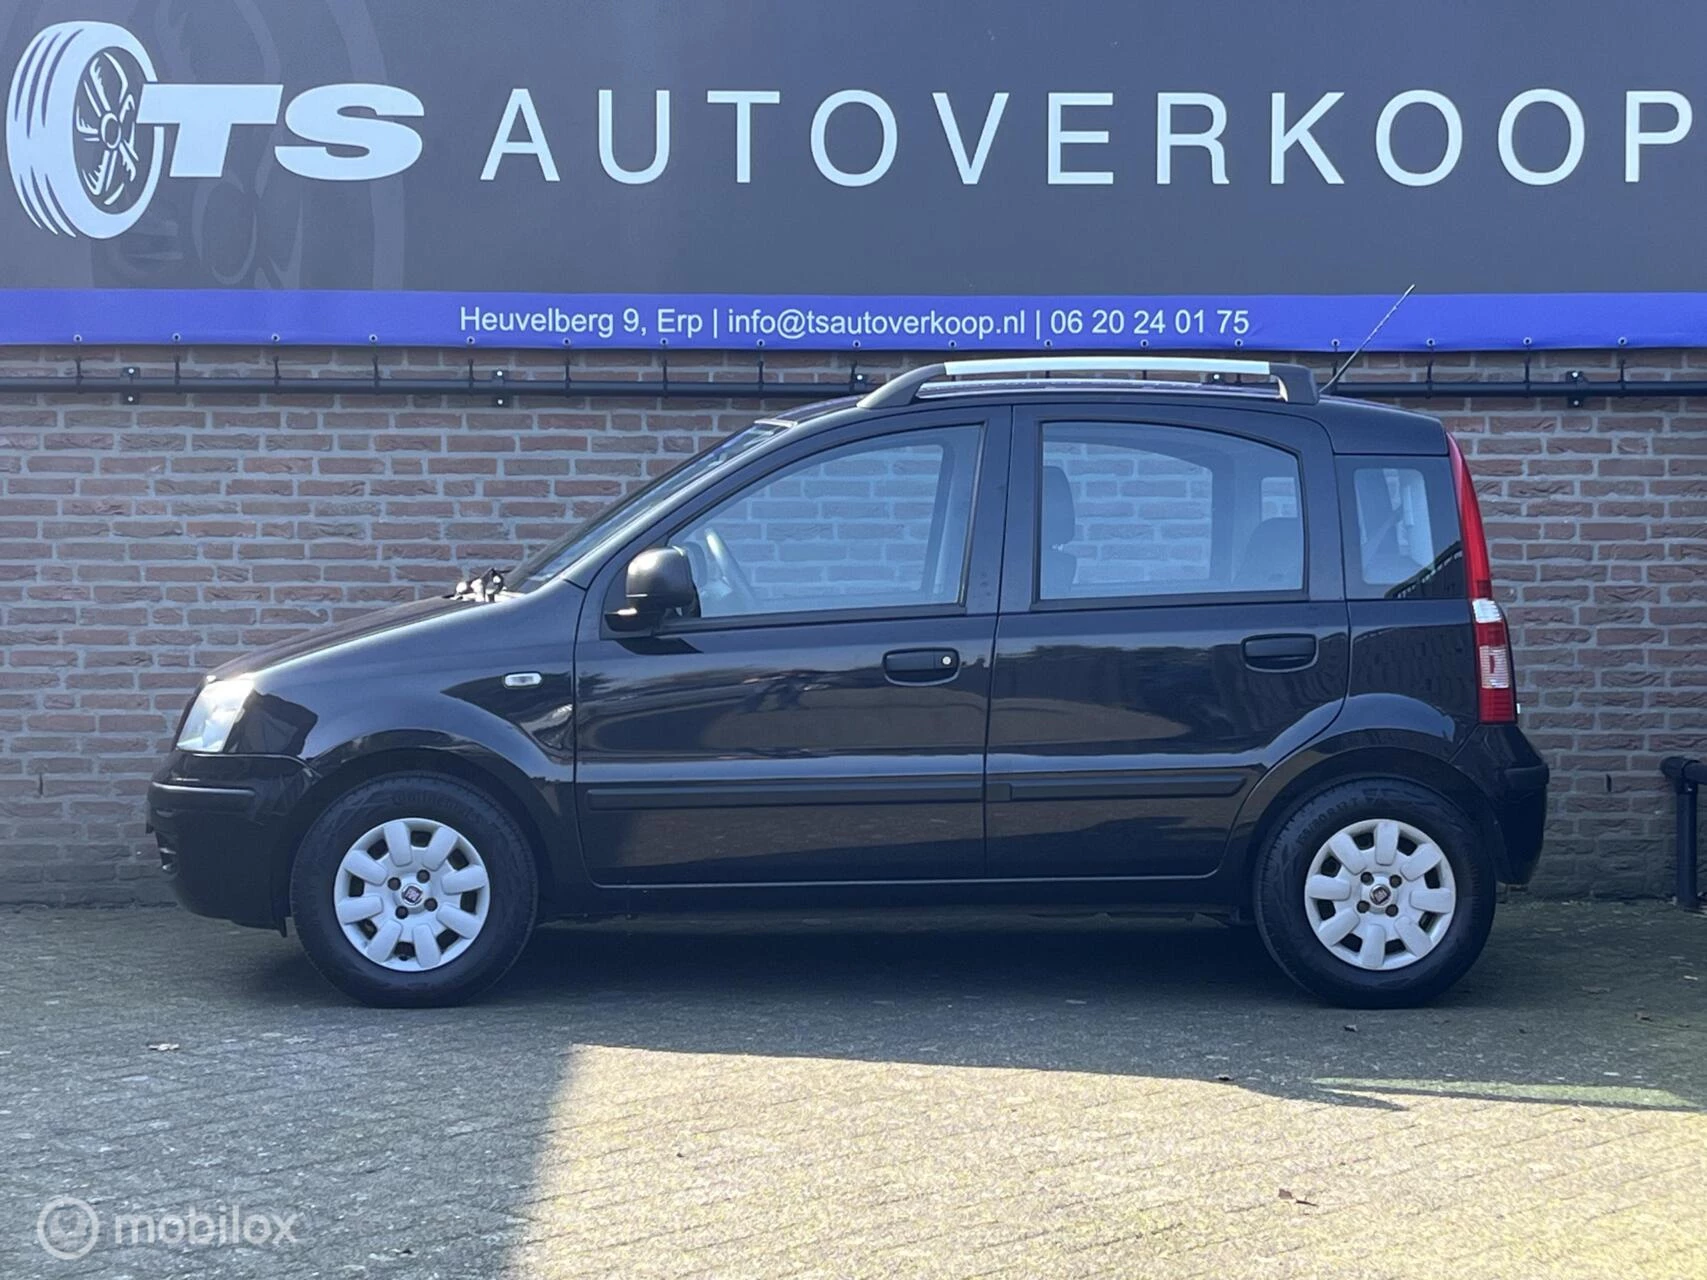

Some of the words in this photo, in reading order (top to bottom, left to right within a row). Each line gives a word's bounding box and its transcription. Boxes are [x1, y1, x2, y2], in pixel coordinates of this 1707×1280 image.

[136, 82, 425, 181] TS
[480, 88, 1694, 187] AUTOVERKOOP
[460, 306, 614, 337] Heuvelberg
[622, 308, 647, 336] 9,
[657, 309, 703, 338] Erp
[728, 308, 1026, 340] info@tsautoverkoop.nl
[1050, 310, 1083, 334] 06
[1091, 310, 1125, 334] 20
[1133, 310, 1167, 334] 24
[1175, 310, 1204, 334] 01
[1217, 310, 1250, 334] 75
